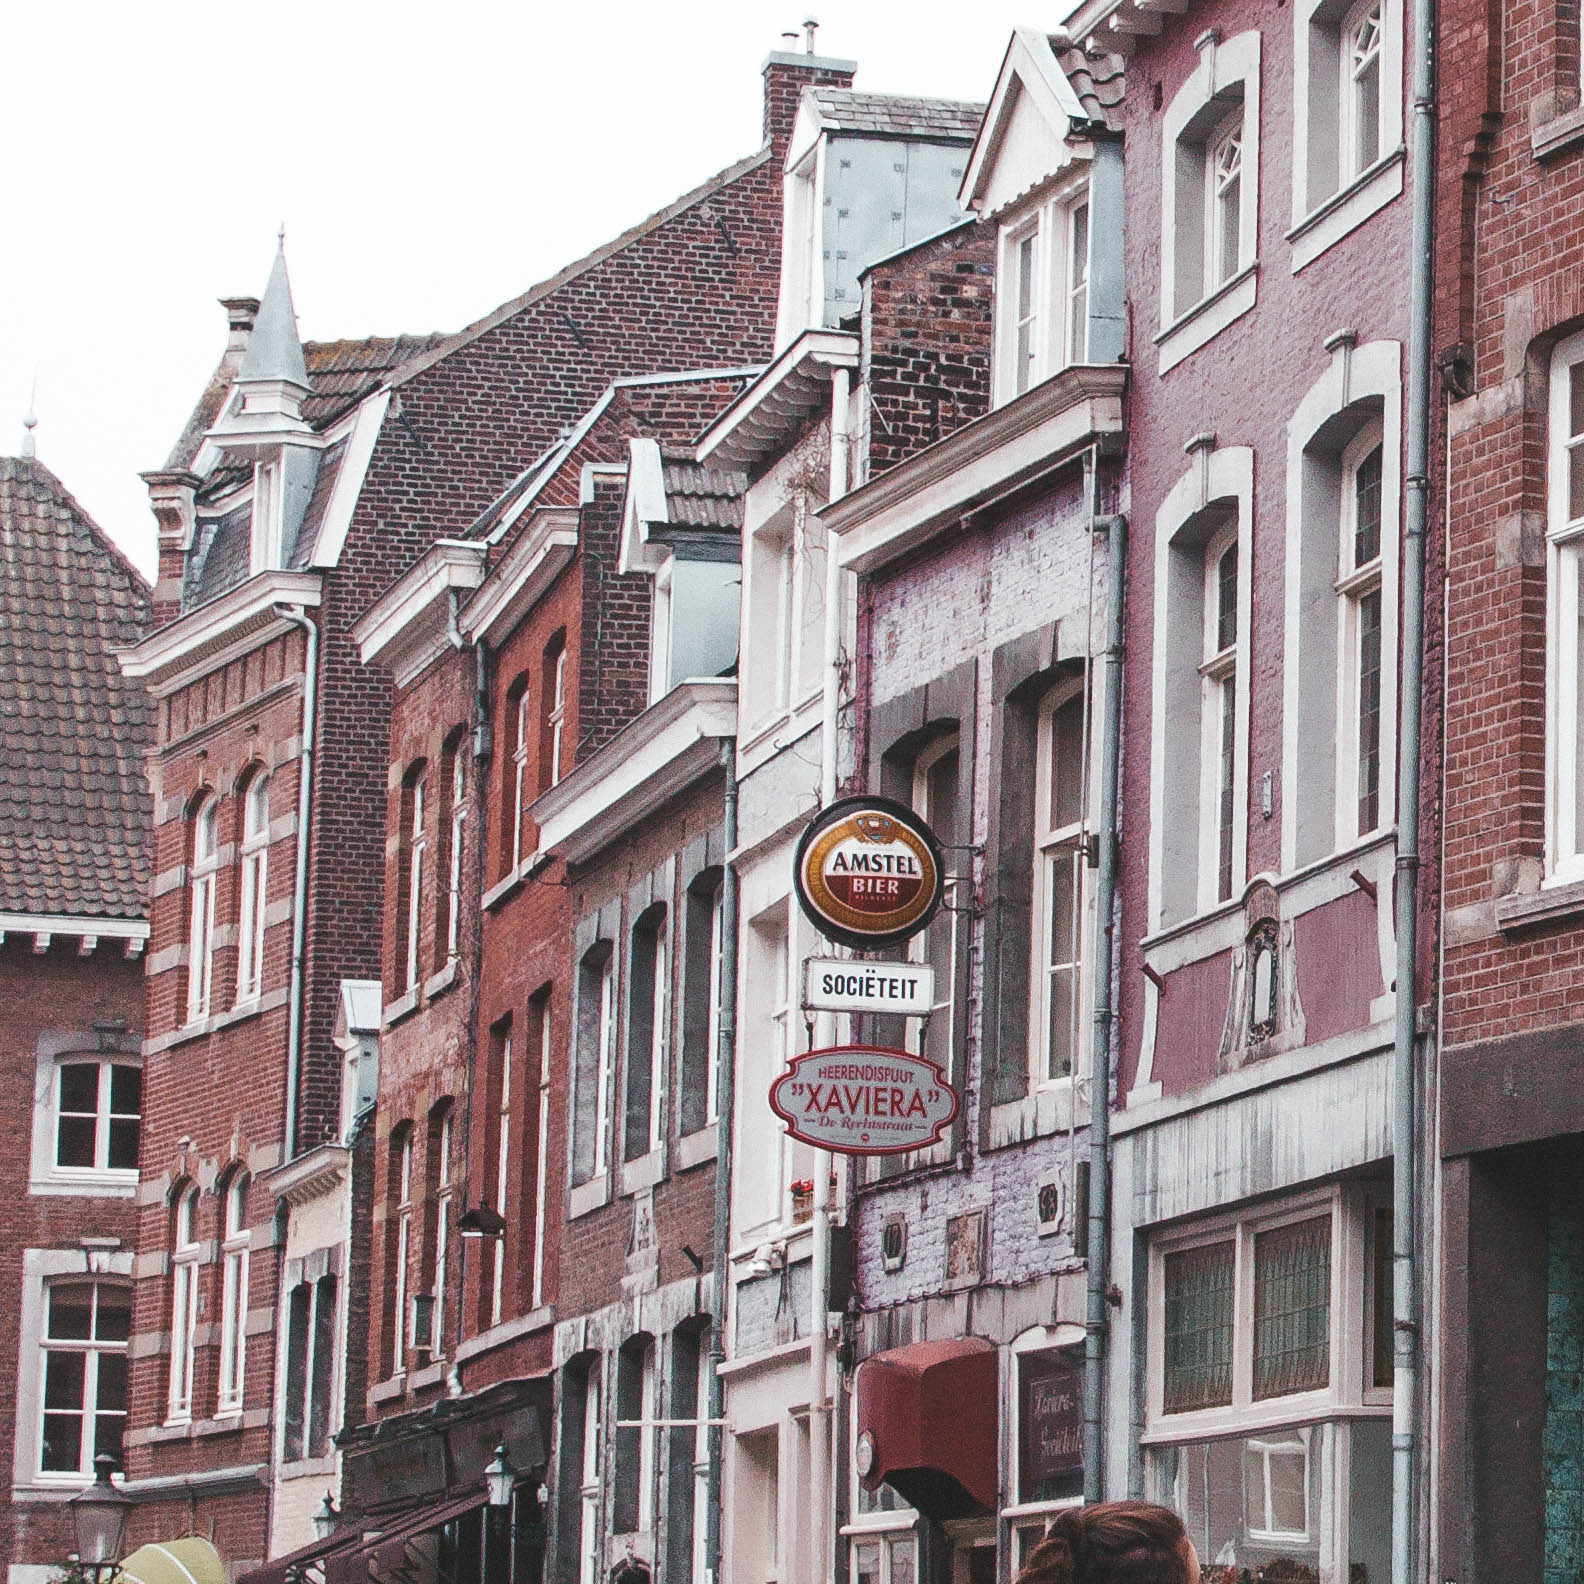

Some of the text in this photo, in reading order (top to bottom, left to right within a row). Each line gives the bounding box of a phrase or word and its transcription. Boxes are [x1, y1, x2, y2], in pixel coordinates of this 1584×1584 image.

[832, 851, 917, 875] AMSTEL
[853, 878, 899, 894] BIER
[822, 968, 918, 999] SOCIËTEIT
